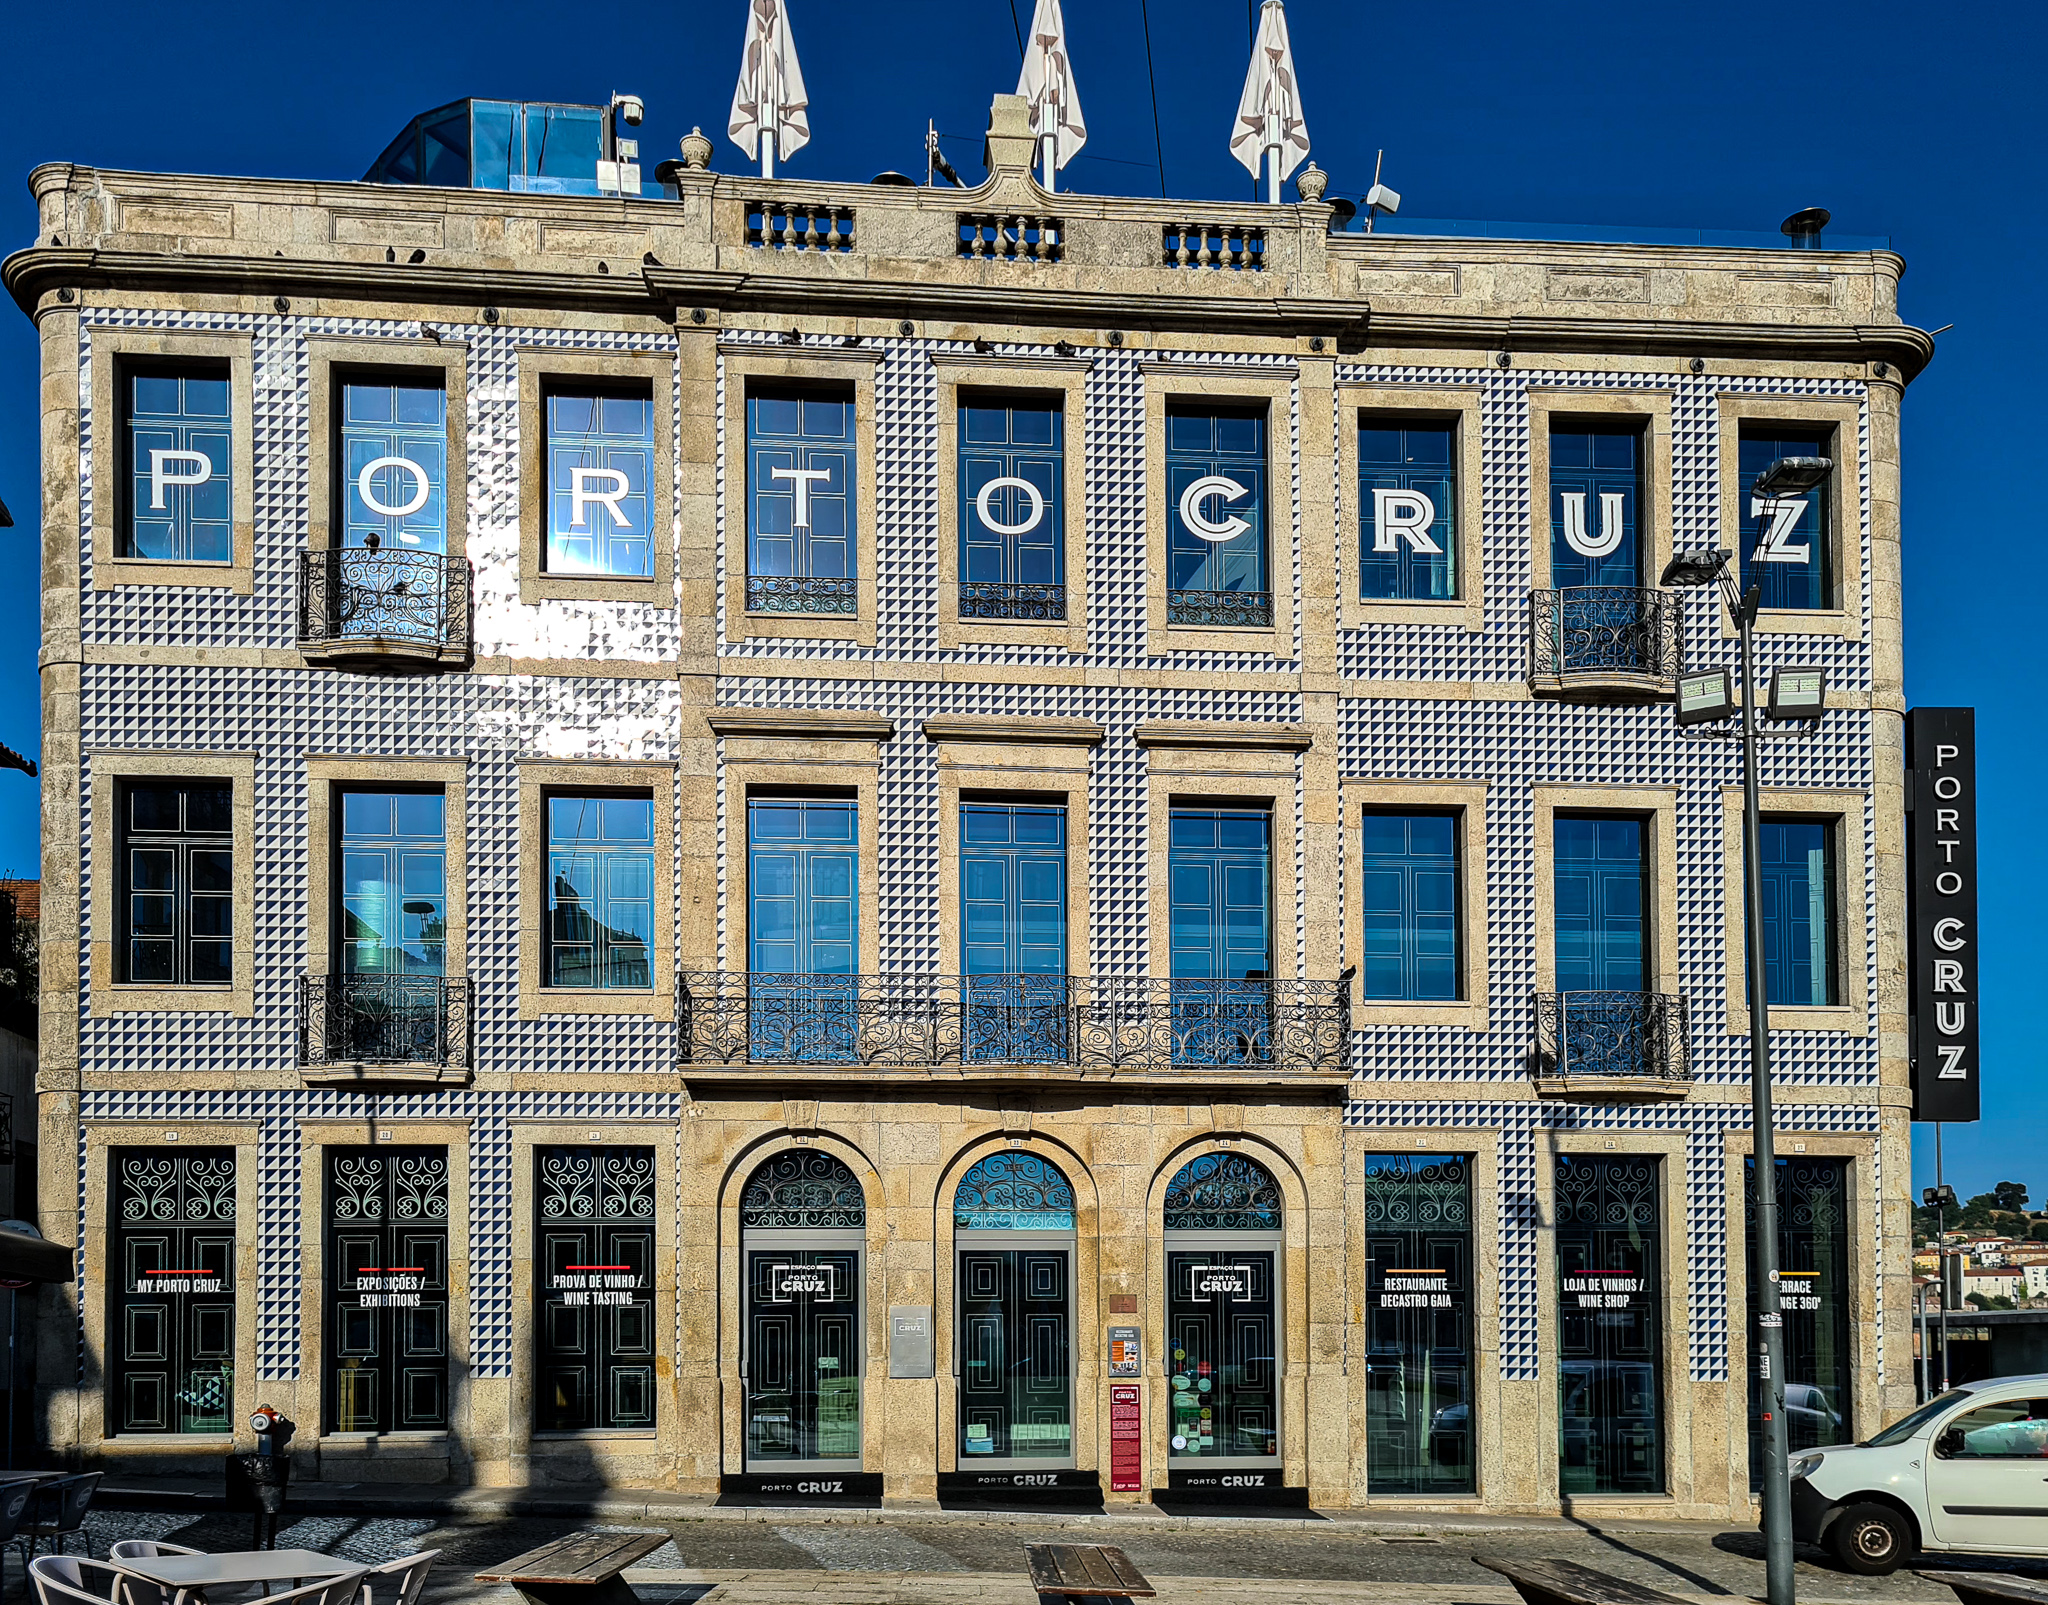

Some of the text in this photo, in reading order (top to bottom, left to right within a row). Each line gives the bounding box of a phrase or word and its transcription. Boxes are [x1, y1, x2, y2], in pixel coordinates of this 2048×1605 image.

[1933, 744, 1967, 1081] PORTO CRUZ
[137, 1278, 221, 1293] MY PORTO CRUZ
[356, 1274, 417, 1293] EXPOSIÇÕES
[553, 1274, 587, 1289] PROVA
[589, 1274, 601, 1289] DE
[604, 1274, 635, 1289] VINHO
[780, 1280, 826, 1292] CRUZ
[1199, 1280, 1243, 1292] CRUZ
[1384, 1277, 1448, 1291] RESTAURANTE
[1563, 1278, 1586, 1291] LOJA
[1588, 1278, 1600, 1291] DE
[1602, 1278, 1637, 1292] VINHOS
[1779, 1280, 1812, 1293] RRACE
[360, 1293, 421, 1307] EXHIBITIONS
[563, 1291, 633, 1305] WINE TASTING
[1380, 1294, 1452, 1308] DECASTRO GAIA
[1578, 1294, 1630, 1308] WINE SHOP
[1780, 1296, 1798, 1310] NGE
[797, 1481, 843, 1493] CRUZ
[1013, 1474, 1058, 1486] CRUZ
[1221, 1475, 1265, 1487] CRUZ
